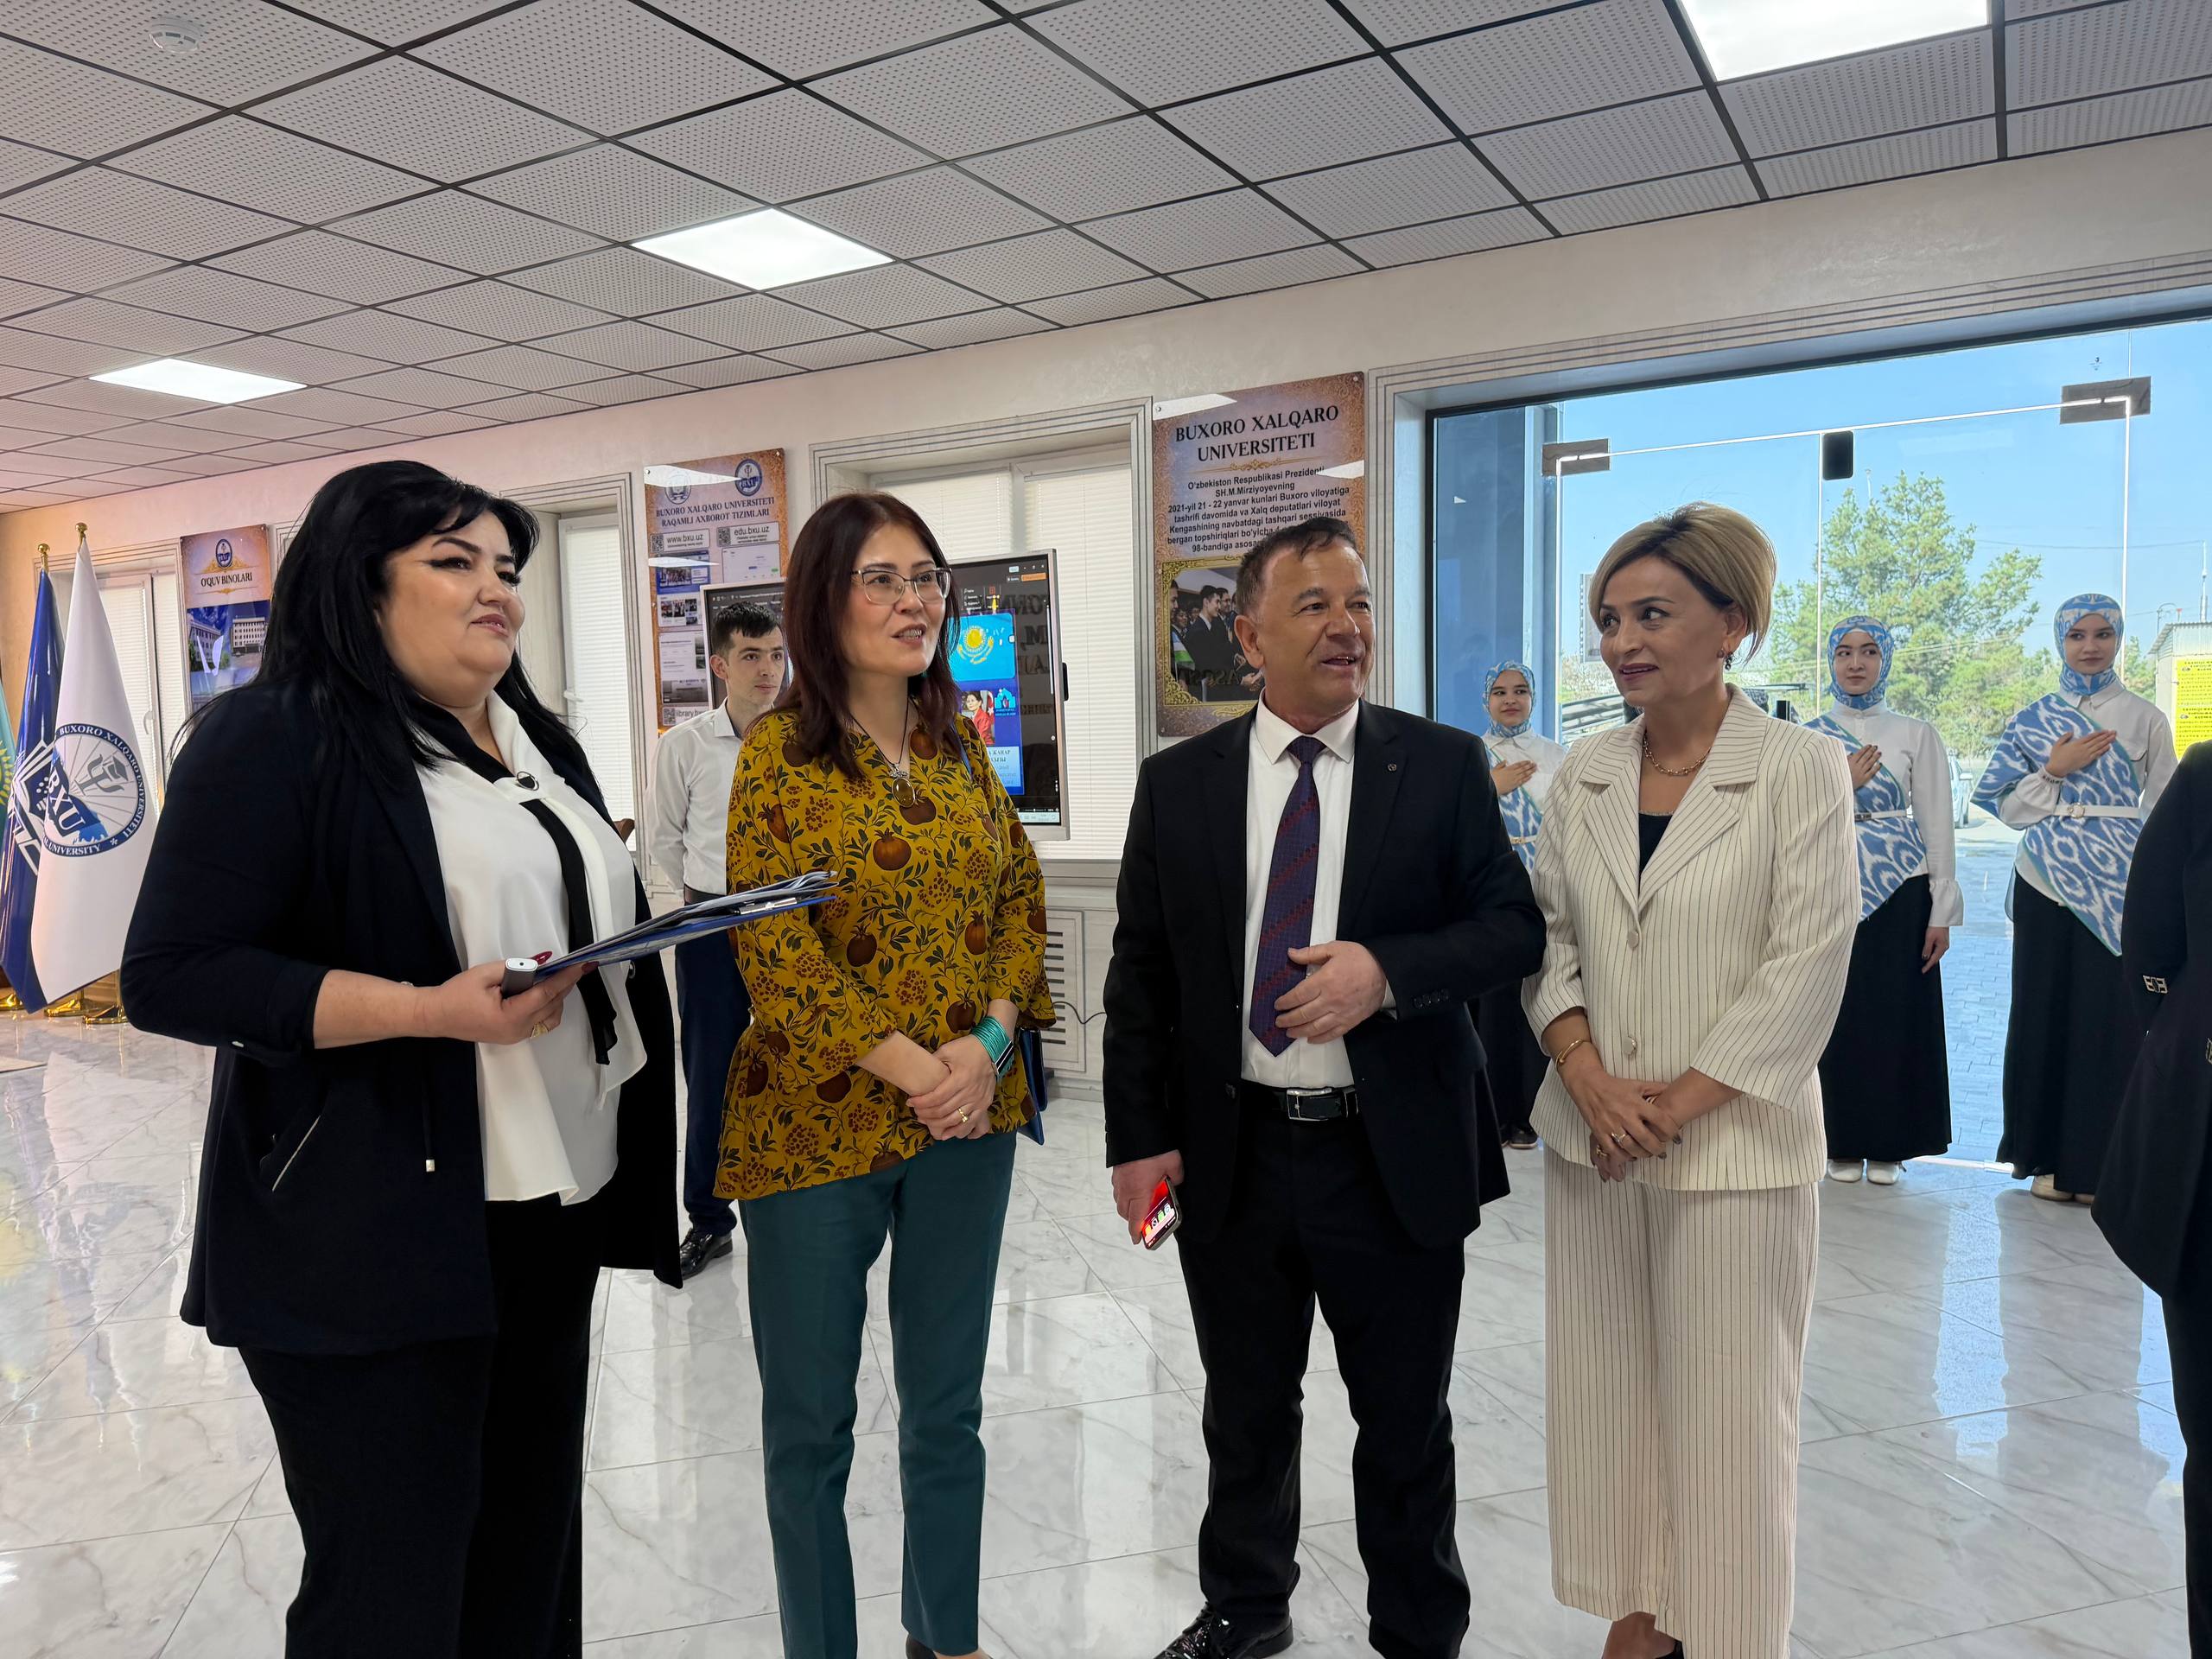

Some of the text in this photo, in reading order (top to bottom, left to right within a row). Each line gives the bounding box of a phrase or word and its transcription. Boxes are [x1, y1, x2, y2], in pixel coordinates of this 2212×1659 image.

[1175, 405, 1338, 442] BUXORO XALQARO
[1198, 432, 1315, 461] UNIVERSITETI
[1187, 479, 1231, 490] O'zbekiston
[1234, 472, 1282, 485] Respublikasi
[1215, 482, 1294, 498] SH.M.Mirziyoyevning
[656, 497, 775, 518] BUXORO XALQARO UNIVERSITETI
[1168, 504, 1196, 513] 2021-yil
[1198, 502, 1206, 511] 21
[1213, 500, 1222, 509] 22
[1224, 498, 1249, 510] yanvar
[1251, 494, 1277, 505] kunlari
[1280, 492, 1308, 501] Buxoro
[1310, 486, 1350, 499] viloyatiga
[661, 508, 770, 527] RAQAMLI AXBOROT TIZIMLARI
[1174, 513, 1199, 523] tashrifi
[1201, 510, 1237, 520] davomida
[1250, 506, 1268, 516] Xalq
[1269, 501, 1312, 513] deputatlari
[1313, 499, 1340, 509] viloyat
[734, 525, 770, 537] edu.bxu.uz
[1169, 521, 1219, 534] Kengashining
[1222, 517, 1263, 528] navbatdagi
[1265, 513, 1297, 524] tashqari
[666, 533, 703, 543] www.bxu.uz
[1167, 536, 1192, 545] bergan
[1194, 531, 1239, 543] topshiriqlari
[1192, 542, 1233, 552] 98-bandiga
[200, 572, 252, 588] O'QUV BINOLARI
[59, 724, 146, 838] BUXORO XALQARO UNIVERSITETI
[48, 769, 86, 831] BXU
[48, 843, 101, 855] UNIVERSITY
